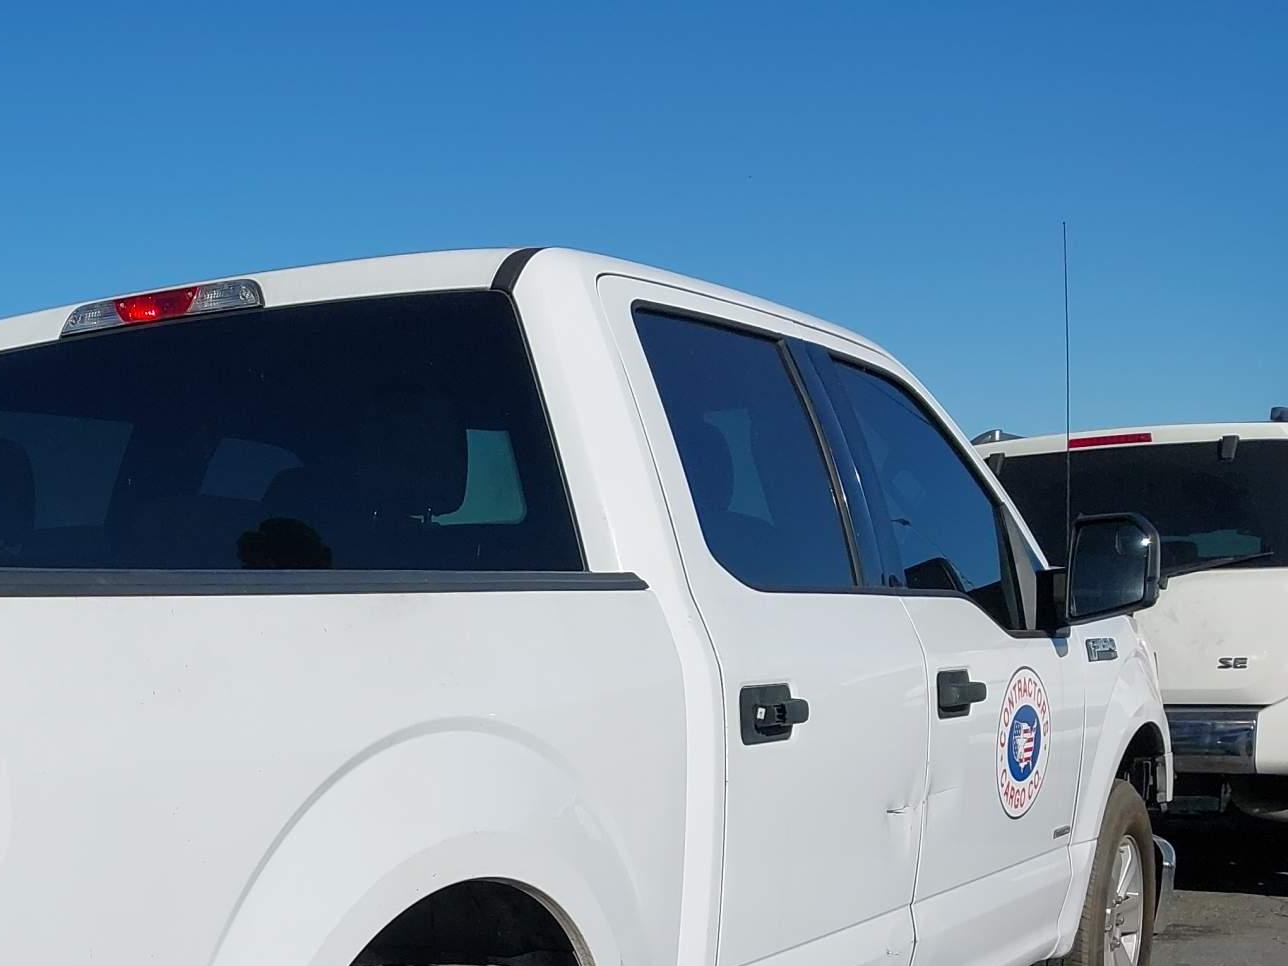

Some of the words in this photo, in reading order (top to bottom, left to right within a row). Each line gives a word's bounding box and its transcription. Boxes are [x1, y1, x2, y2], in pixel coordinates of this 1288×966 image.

[1217, 657, 1248, 669] SE
[999, 676, 1049, 748] CONTRACTORS
[1000, 768, 1027, 810] CARGO
